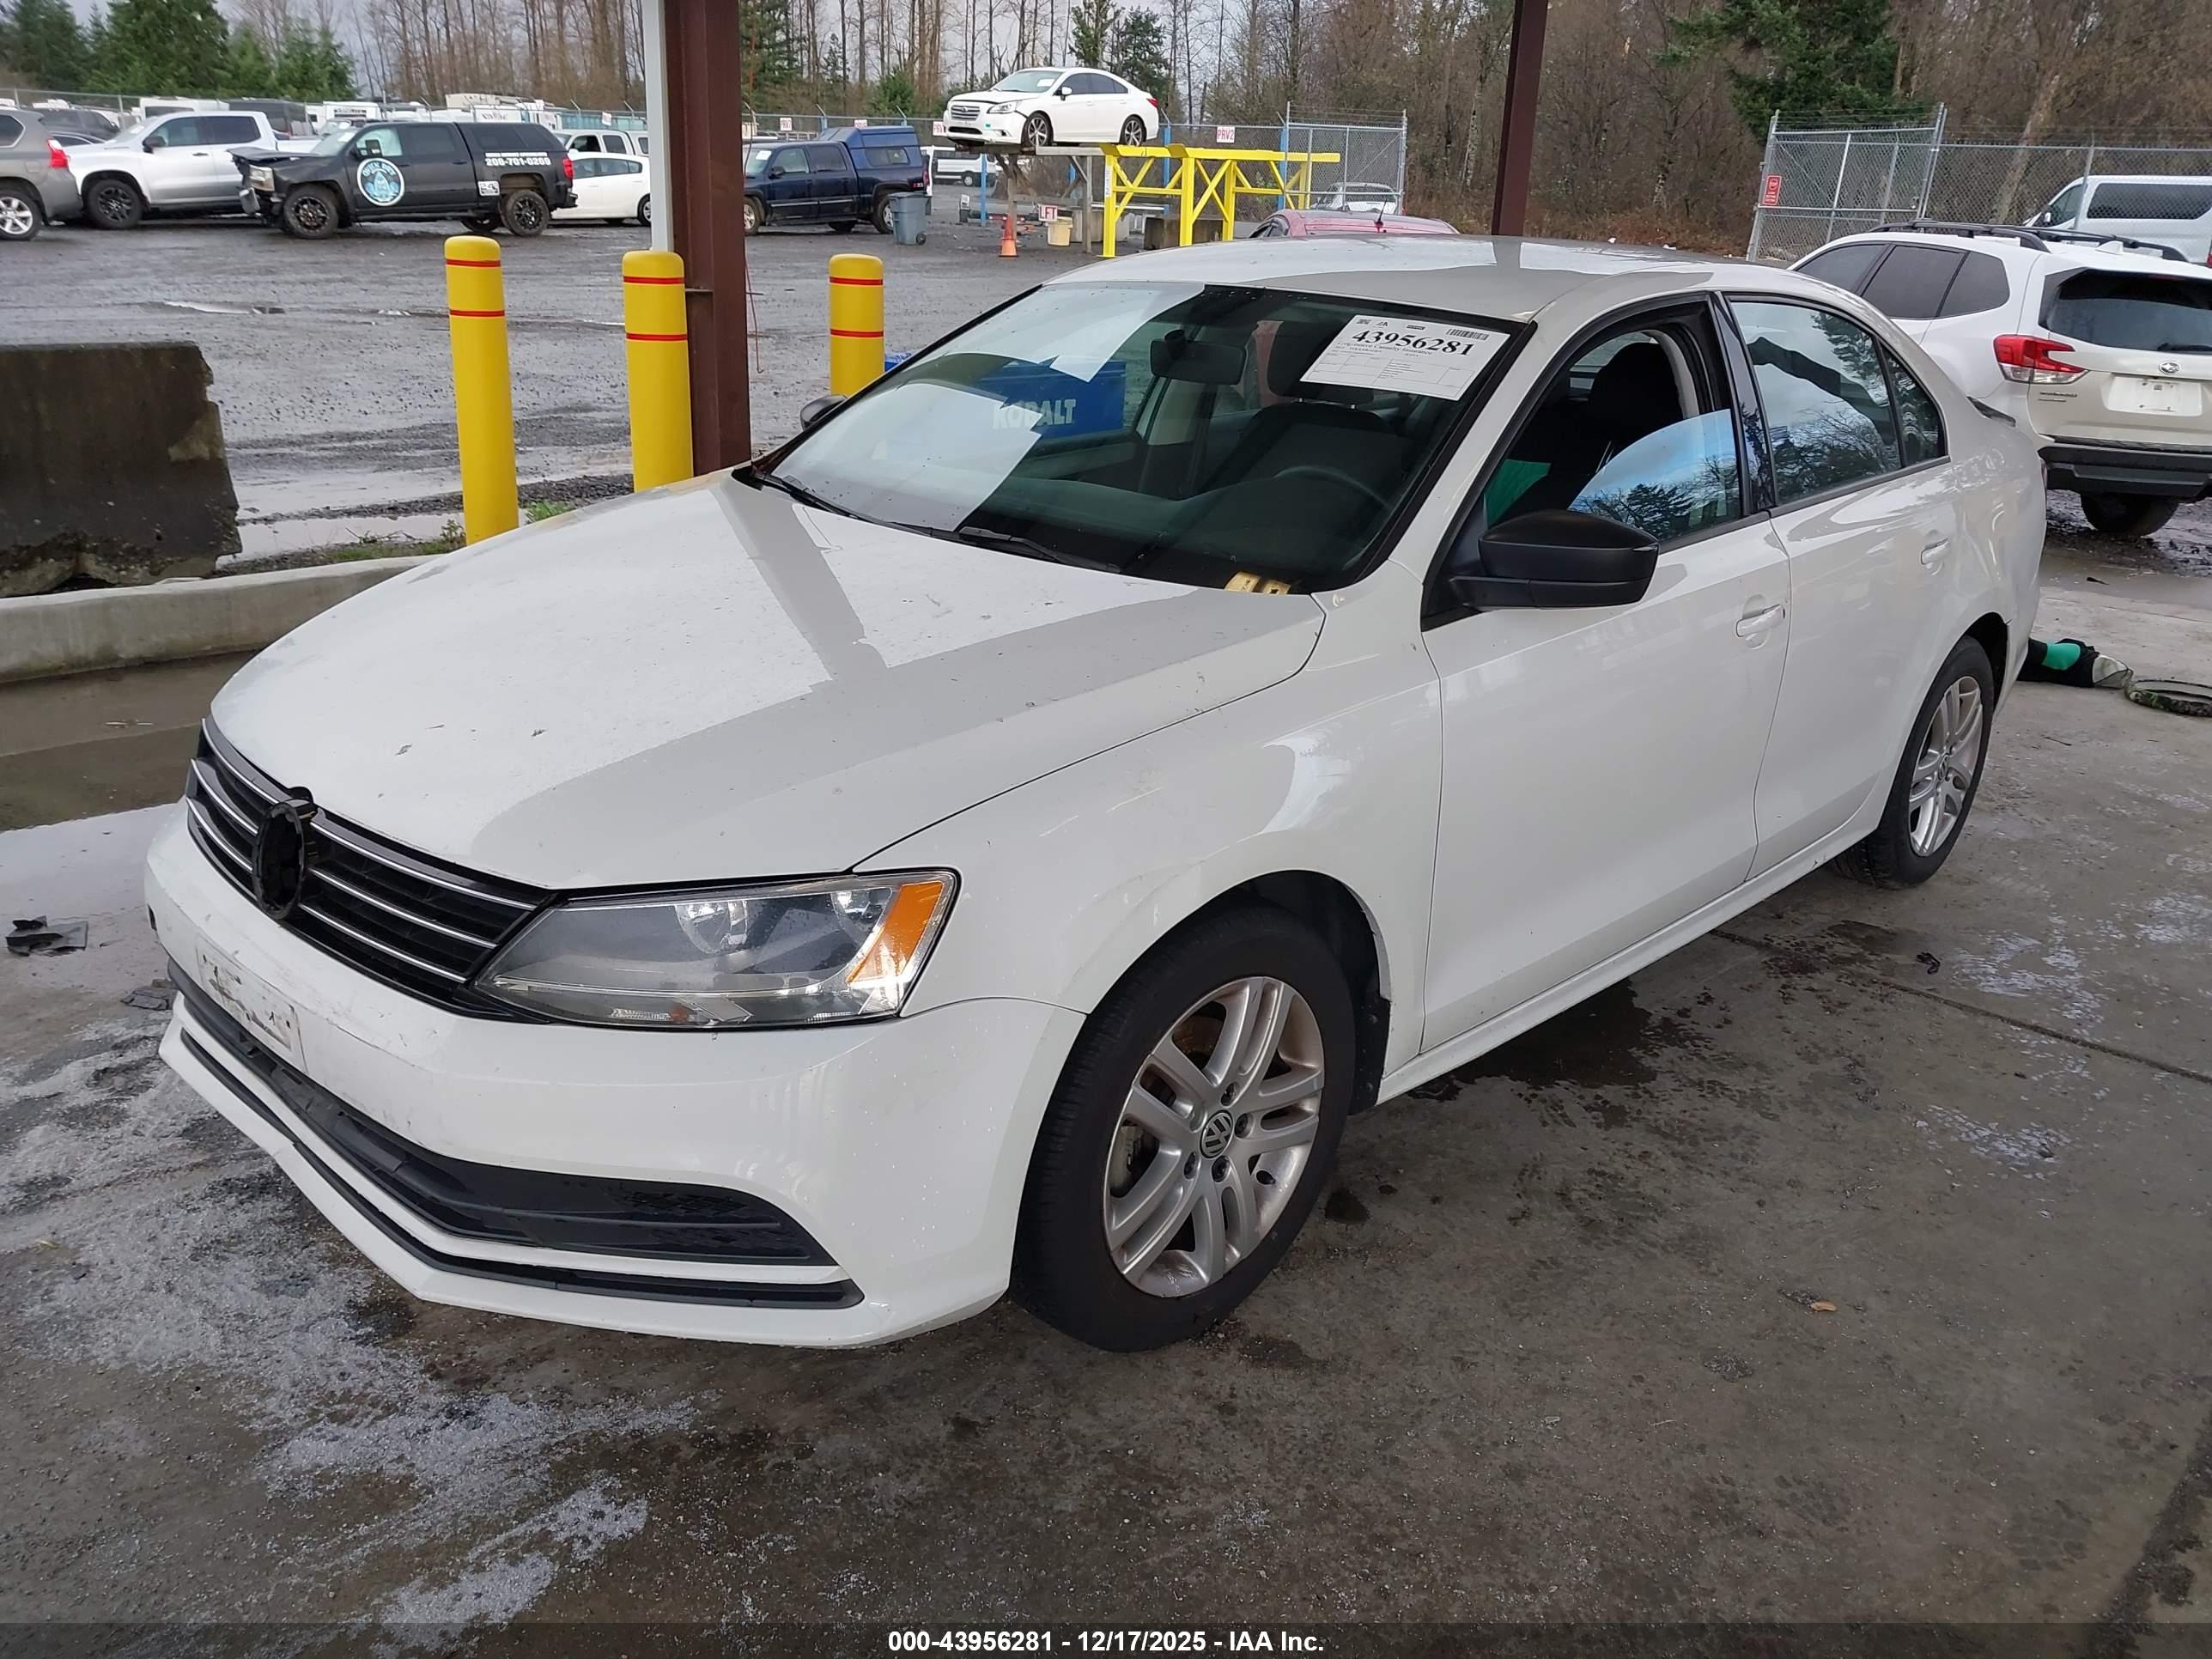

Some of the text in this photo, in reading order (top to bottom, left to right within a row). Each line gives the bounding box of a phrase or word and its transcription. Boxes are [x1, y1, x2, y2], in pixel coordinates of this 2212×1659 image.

[1217, 129, 1234, 140] PRV2
[1352, 330, 1475, 356] 43956281
[993, 398, 1077, 429] KOBALT
